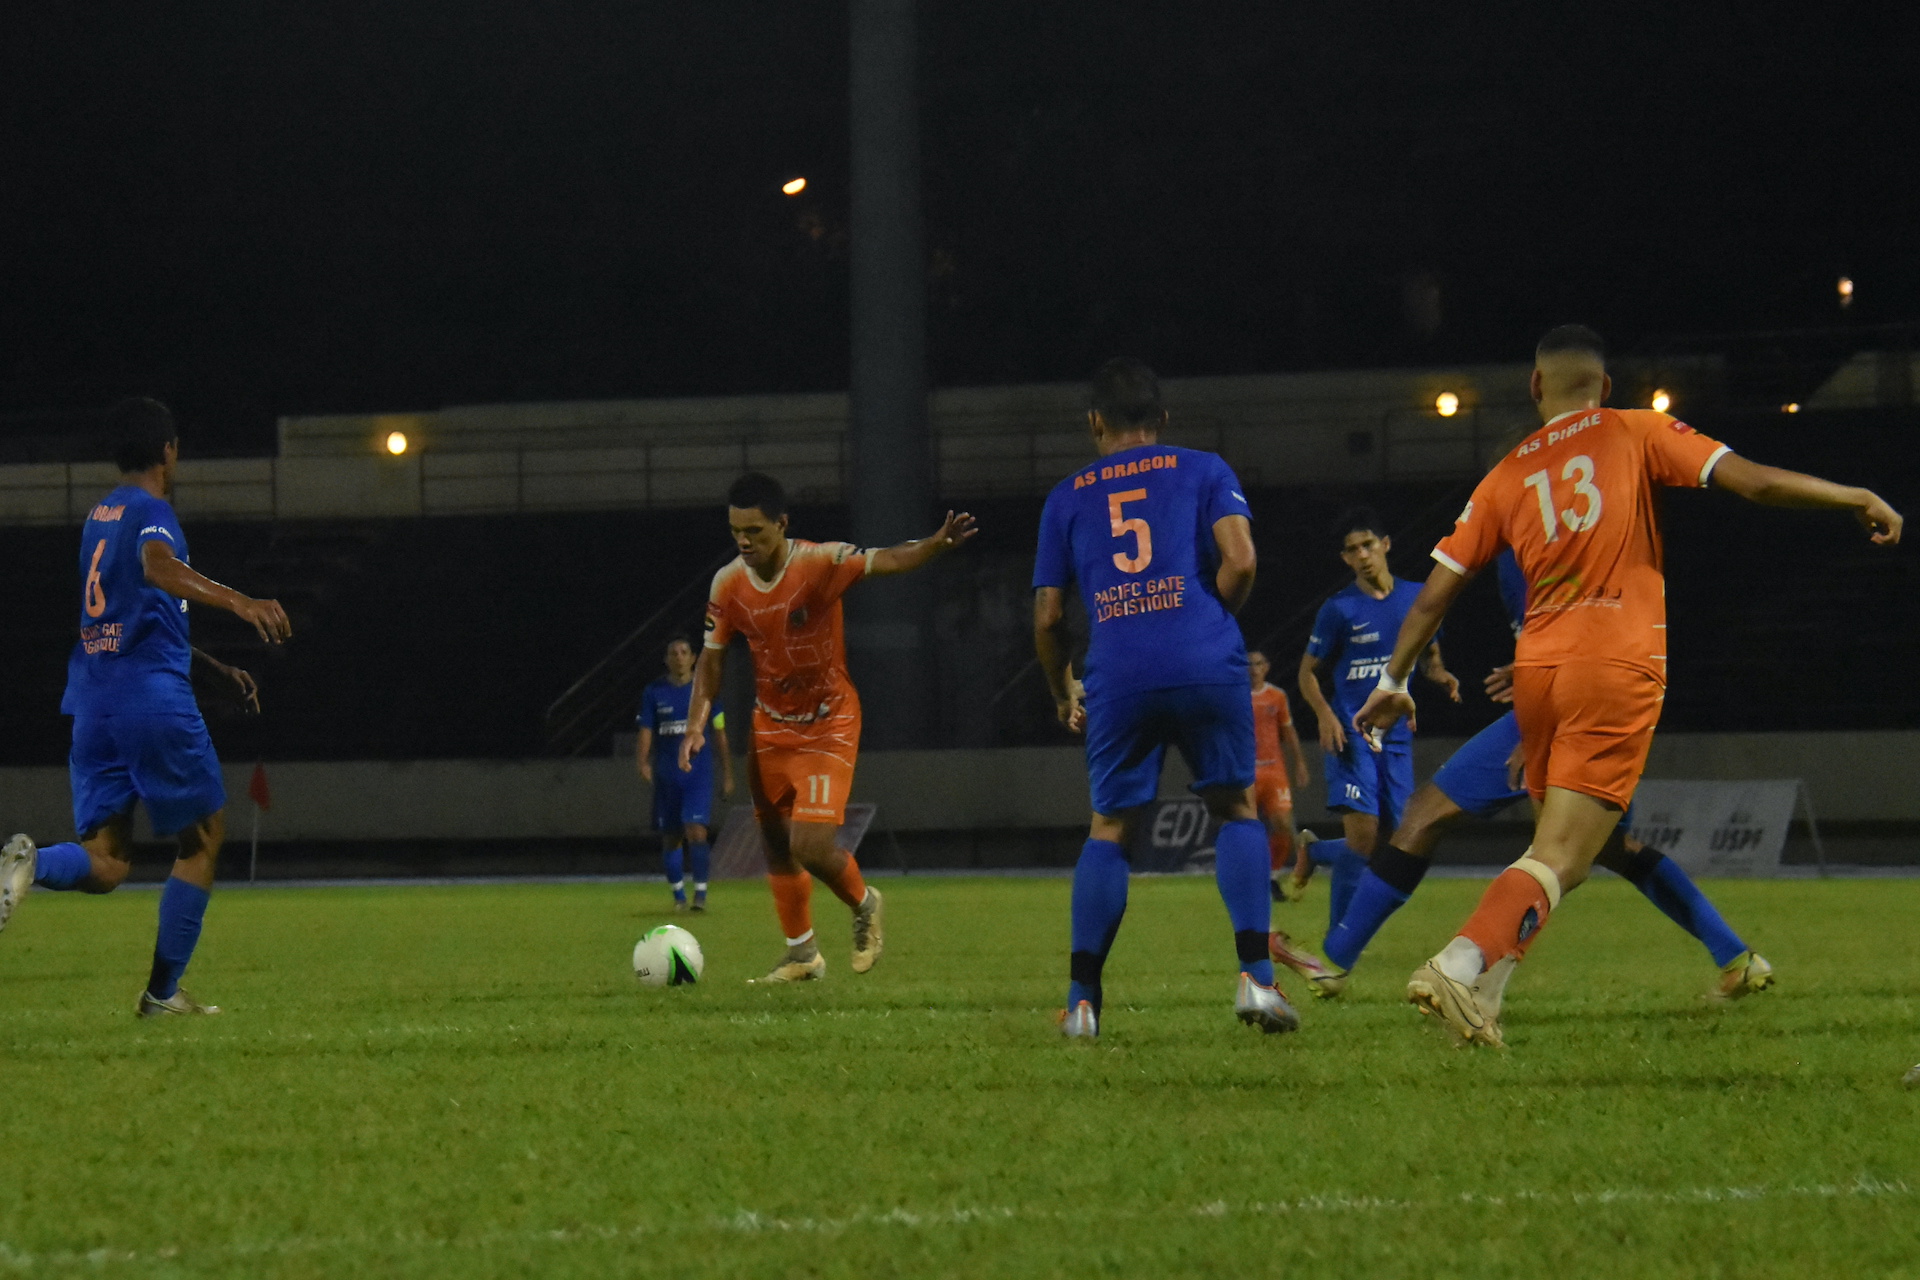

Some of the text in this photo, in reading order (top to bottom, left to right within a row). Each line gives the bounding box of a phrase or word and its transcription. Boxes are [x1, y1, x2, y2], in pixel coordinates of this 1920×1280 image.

[1516, 412, 1601, 458] AS PIRAE
[1073, 454, 1178, 490] AS DRAGON
[1524, 455, 1602, 544] 13
[1107, 488, 1153, 574] 5
[85, 538, 106, 618] 6
[1094, 575, 1186, 607] PACIFC GATE
[1097, 591, 1184, 623] LOGISTIQUE
[807, 774, 831, 804] 11
